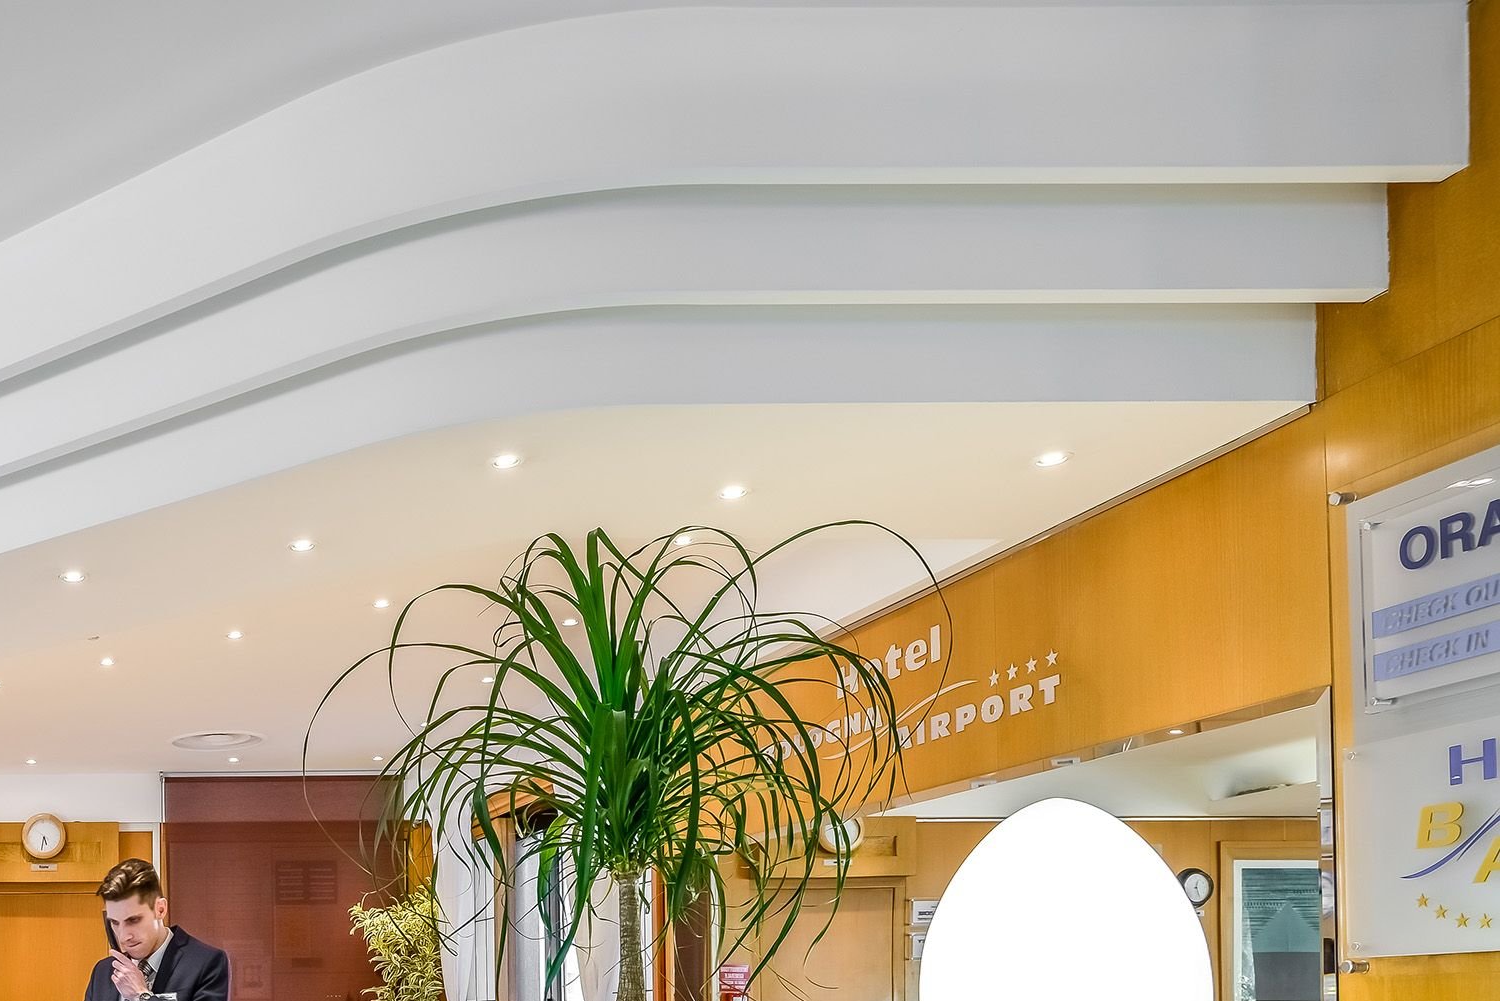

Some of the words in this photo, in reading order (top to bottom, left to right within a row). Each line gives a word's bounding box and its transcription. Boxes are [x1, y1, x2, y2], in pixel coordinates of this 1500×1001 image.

[1384, 591, 1459, 630] CHECK
[836, 624, 942, 700] Hotel
[1385, 637, 1461, 674] CHECK
[1466, 629, 1490, 653] IN
[892, 674, 1061, 753] AIRPORT
